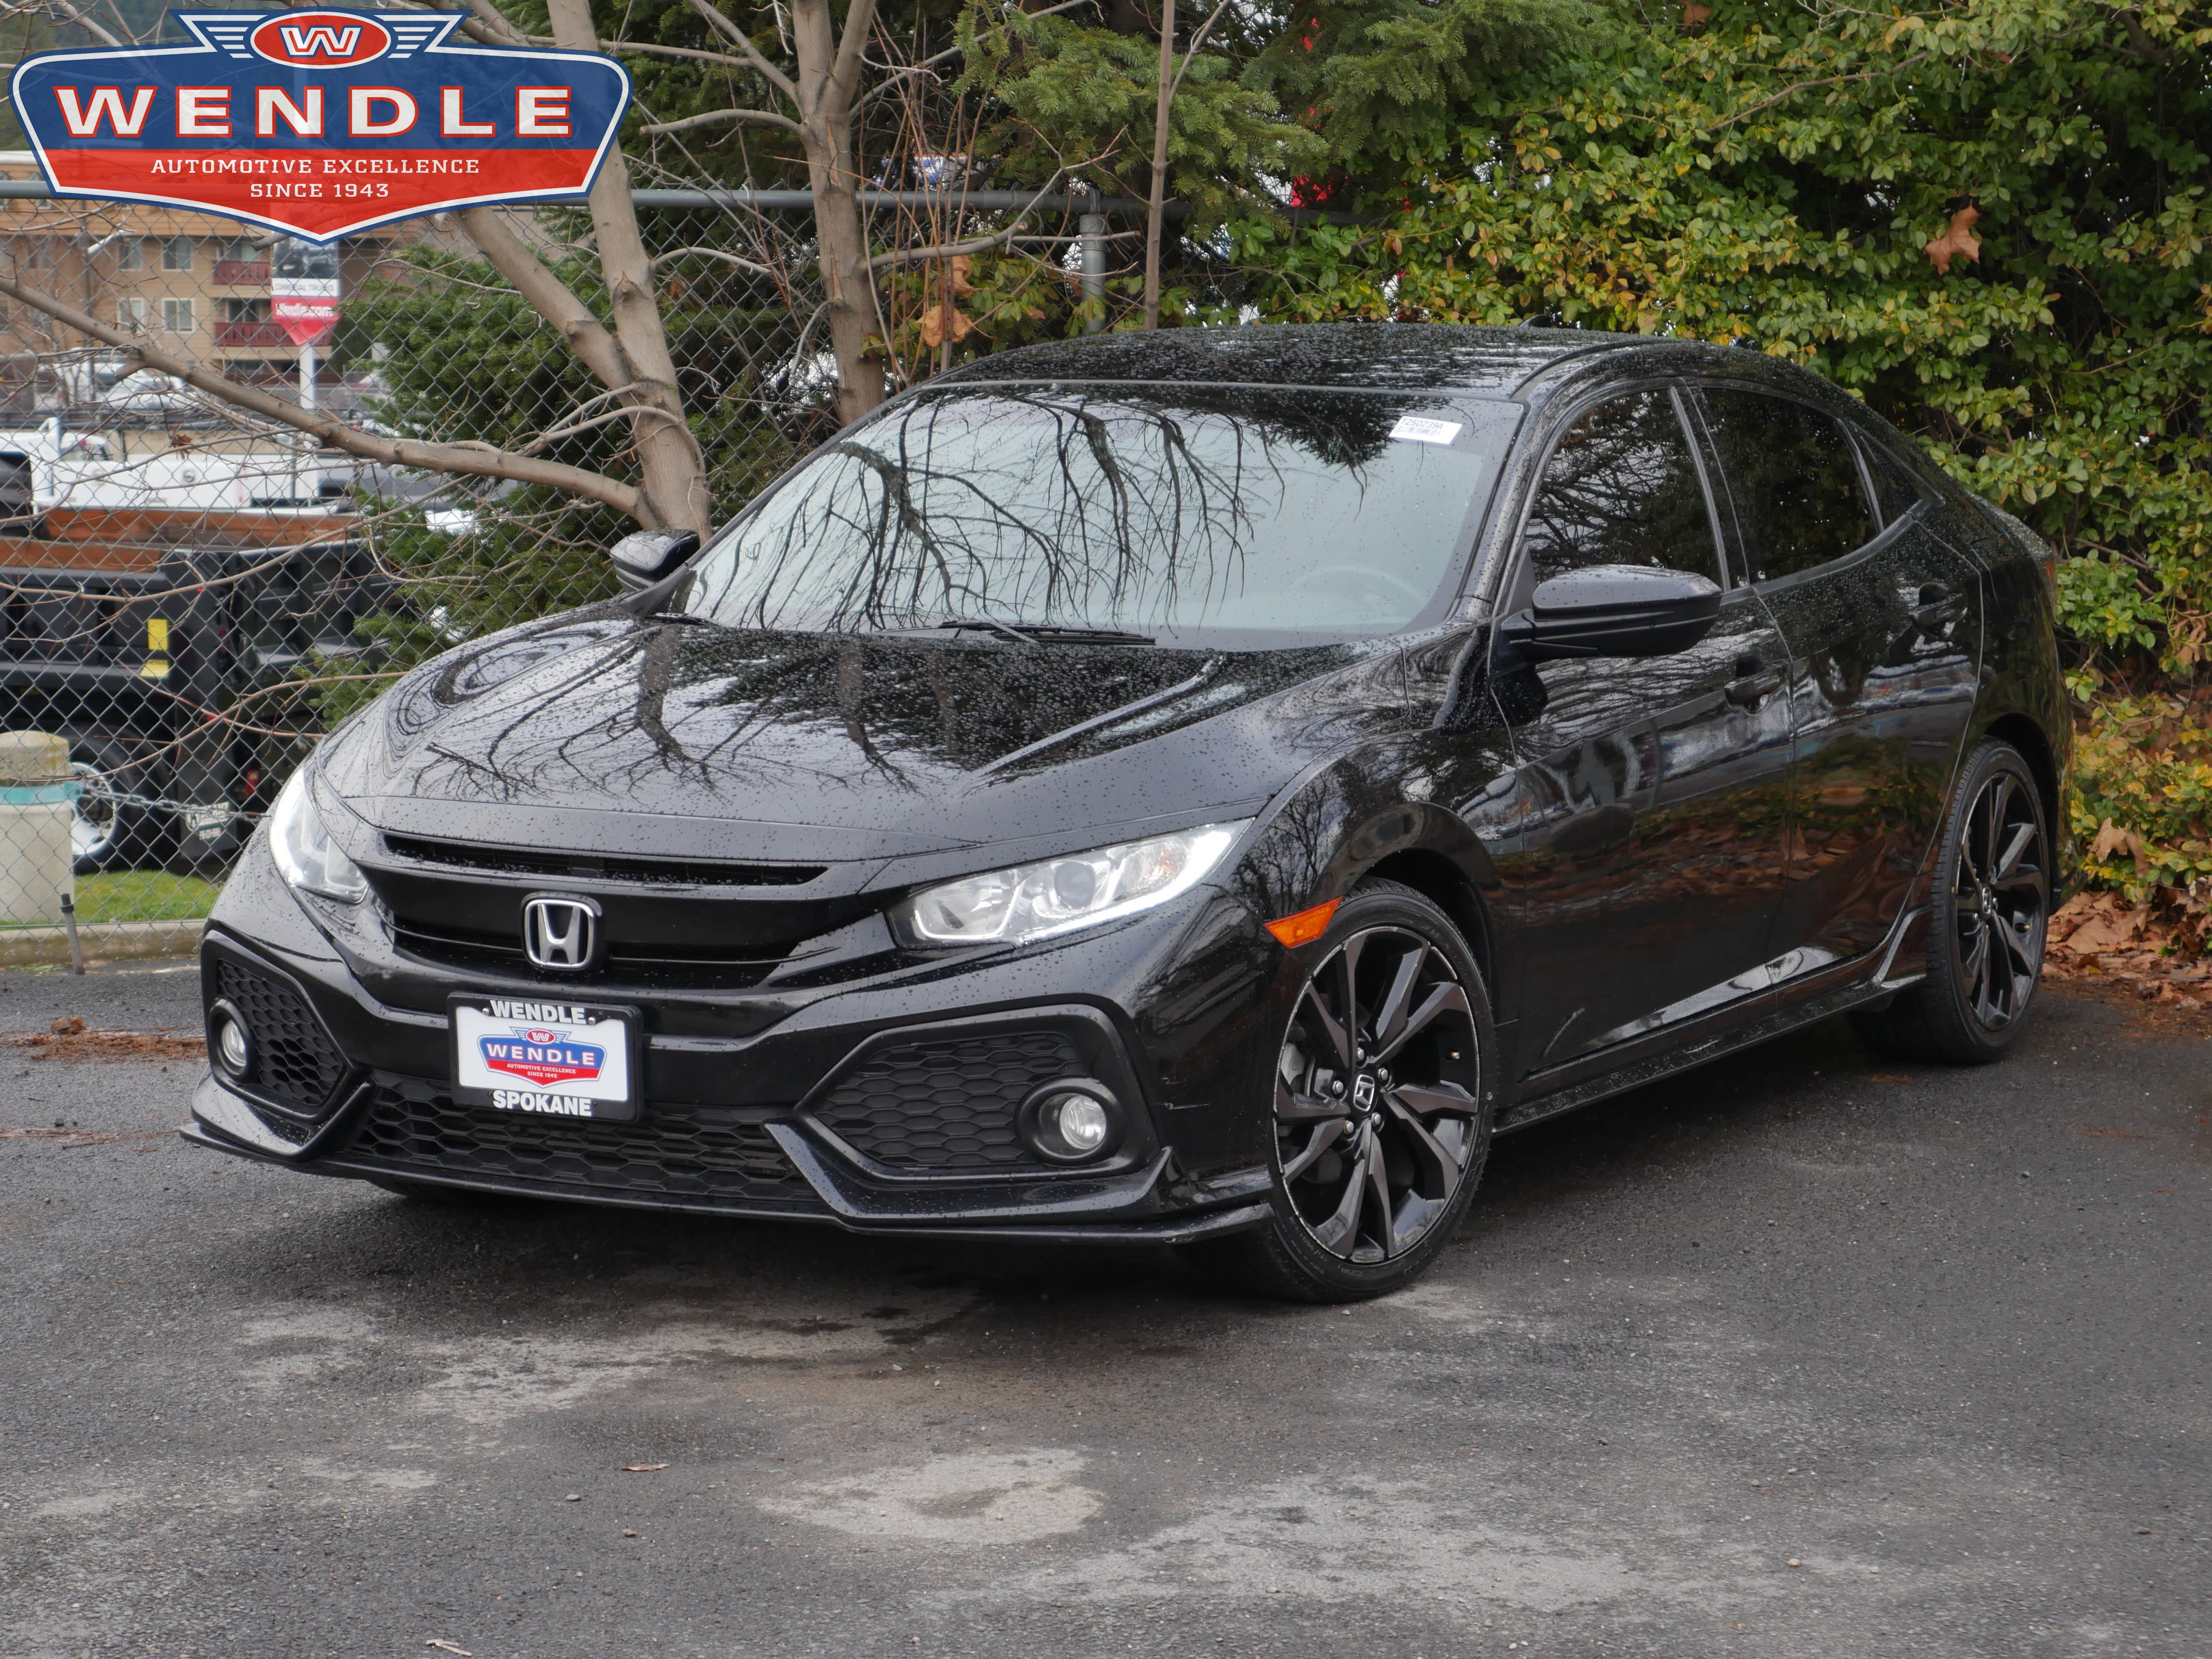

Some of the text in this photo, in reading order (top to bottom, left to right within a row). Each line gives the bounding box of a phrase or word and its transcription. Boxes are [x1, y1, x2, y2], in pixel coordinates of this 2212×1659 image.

[1400, 417, 1443, 430] T250239A
[490, 1000, 587, 1024] WENDLE
[487, 1044, 595, 1066] WENDLE
[507, 1063, 541, 1071] AUTOMOTIVE
[493, 1090, 591, 1117] SPOKANE
